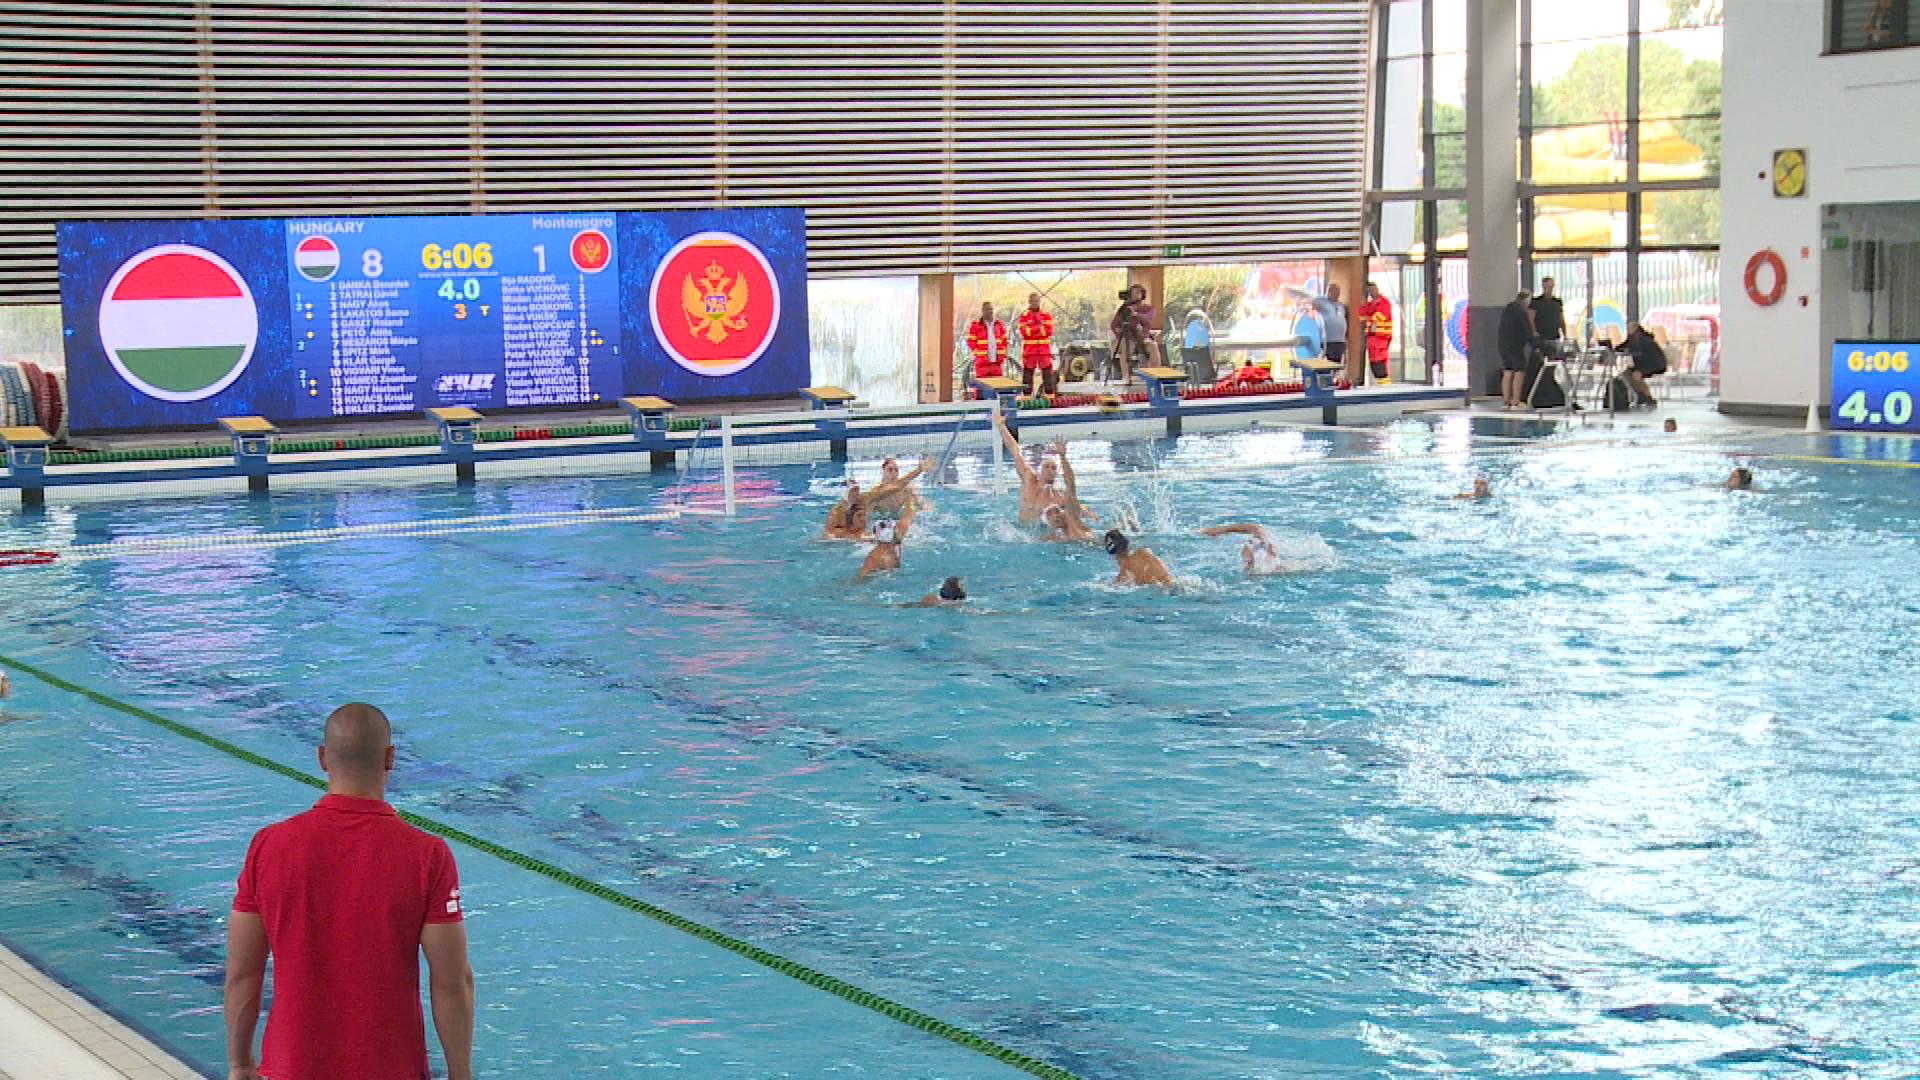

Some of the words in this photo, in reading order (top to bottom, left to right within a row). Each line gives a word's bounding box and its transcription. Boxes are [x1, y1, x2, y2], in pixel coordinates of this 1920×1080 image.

[289, 221, 365, 234] HUNGARY
[533, 216, 613, 230] Montenegro
[362, 248, 383, 277] 8
[422, 243, 493, 269] 6:06
[534, 245, 546, 272] 1
[438, 279, 480, 301] 4.0
[455, 303, 467, 318] 3
[1847, 351, 1909, 372] 6:06
[1838, 390, 1913, 424] 4.0
